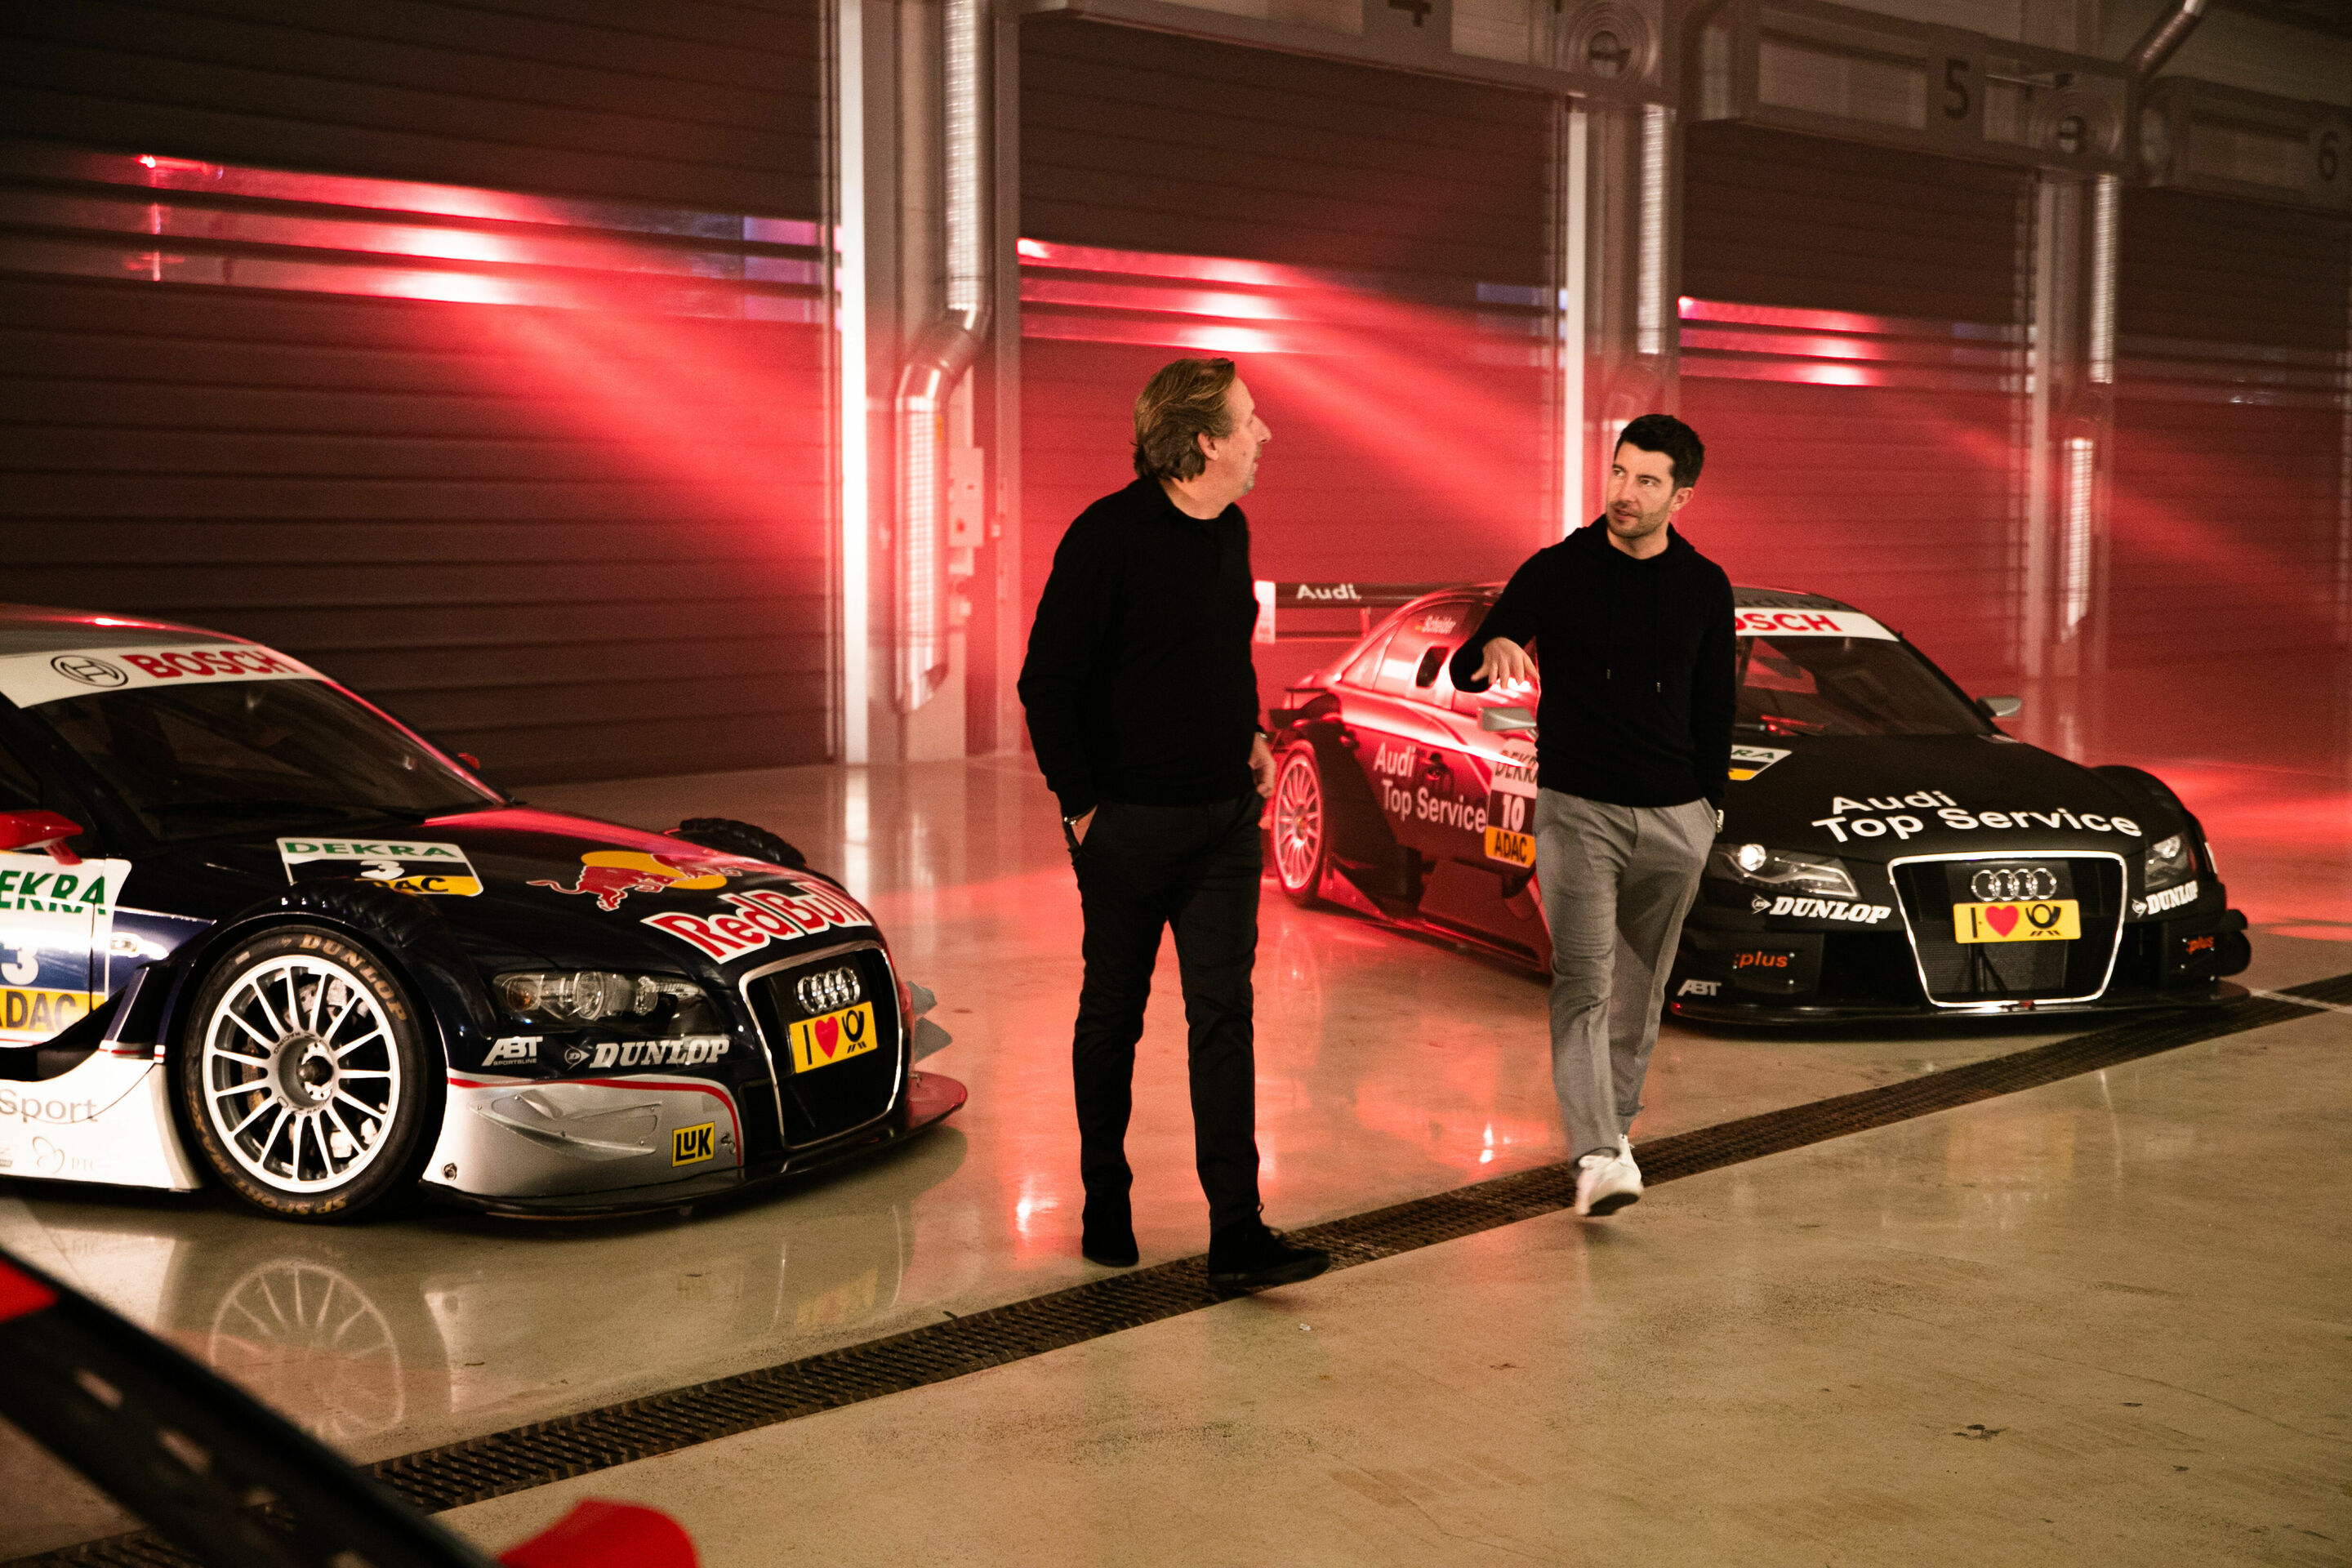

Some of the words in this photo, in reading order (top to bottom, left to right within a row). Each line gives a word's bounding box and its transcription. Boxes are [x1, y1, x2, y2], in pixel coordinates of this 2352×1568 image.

[1944, 58, 1969, 119] 5
[2318, 131, 2338, 180] 6
[1296, 583, 1356, 599] Audi
[1735, 613, 1842, 631] SCH
[120, 651, 301, 679] BOSCH
[1374, 742, 1417, 777] Audi
[1381, 779, 1412, 821] Top
[1417, 785, 1487, 834] Service
[1502, 794, 1526, 833] 10
[1833, 790, 1958, 815] Audi
[1811, 814, 1924, 843] Top
[1937, 808, 2142, 837] Service
[284, 842, 460, 858] DEKRA
[1494, 831, 1527, 863] ADAC
[360, 860, 405, 880] 3
[0, 870, 106, 915] EKRA
[2145, 880, 2198, 915] DUNLOP
[1769, 896, 1891, 924] DUNLOP
[299, 934, 408, 1022] DUNLOP
[1677, 979, 1722, 996] ABT
[0, 991, 76, 1031] DAC
[482, 1036, 543, 1067] ABT
[589, 1038, 730, 1068] DUNLOP
[0, 1089, 98, 1123] Sport
